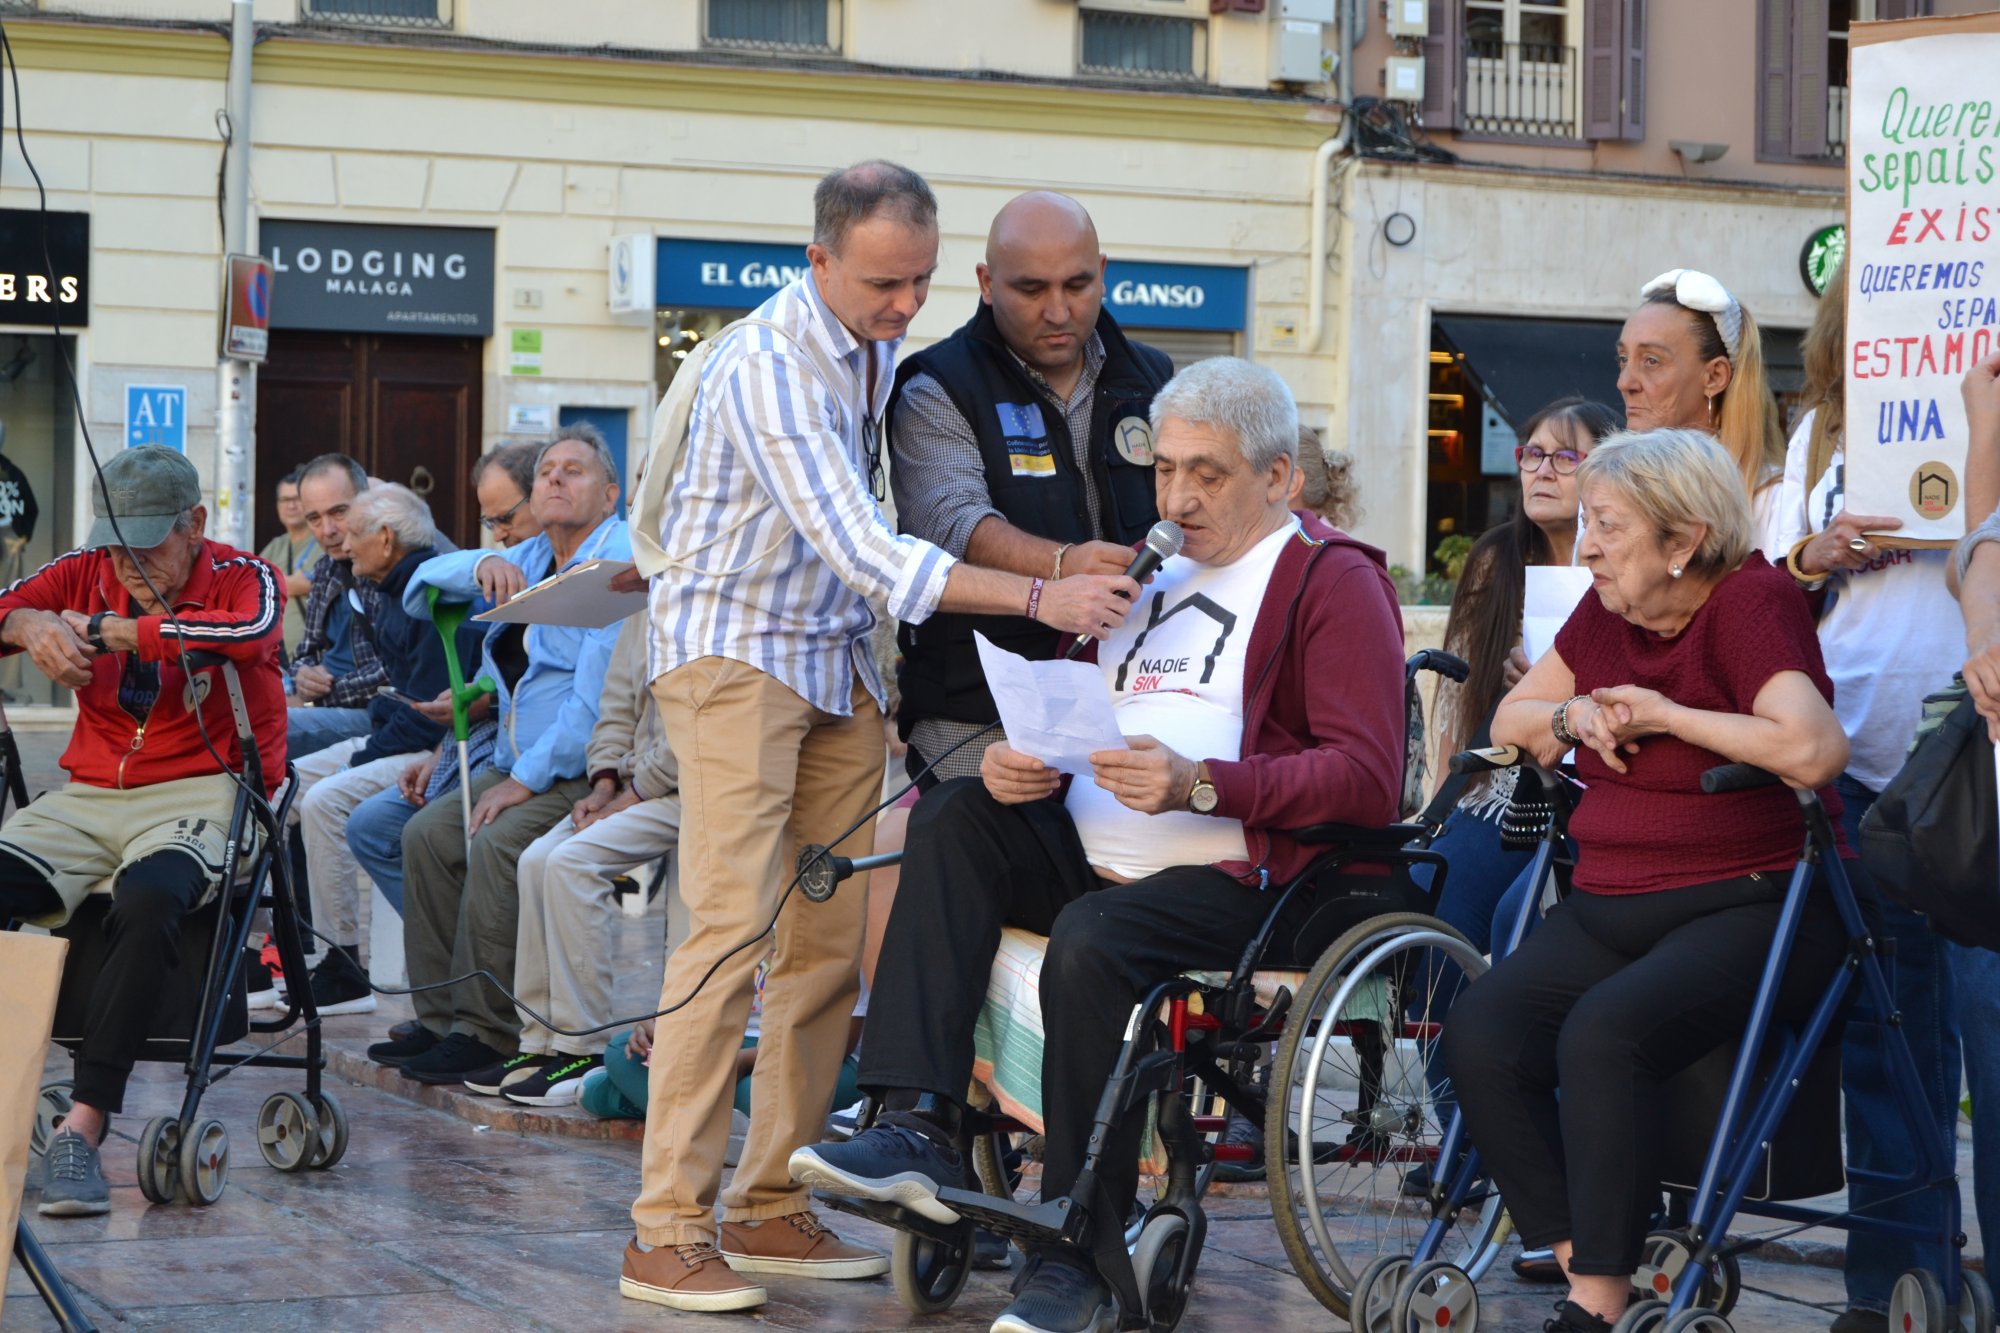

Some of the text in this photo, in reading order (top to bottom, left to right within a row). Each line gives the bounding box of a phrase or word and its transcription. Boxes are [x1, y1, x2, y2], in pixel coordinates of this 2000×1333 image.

[272, 246, 467, 280] LODGING
[701, 262, 809, 288] EL GAN
[0, 273, 78, 303] ERS
[326, 279, 413, 297] MALAGA
[1112, 280, 1205, 308] GANSO
[1860, 261, 1984, 303] QUEREMOS
[386, 310, 479, 325] APARTAMENTOS
[1938, 297, 2000, 329] SEPA
[133, 392, 180, 427] AT
[1878, 398, 1945, 444] UNA
[1850, 549, 1912, 576] OGAR
[1139, 657, 1190, 674] NADIE
[1132, 675, 1163, 692] SIN
